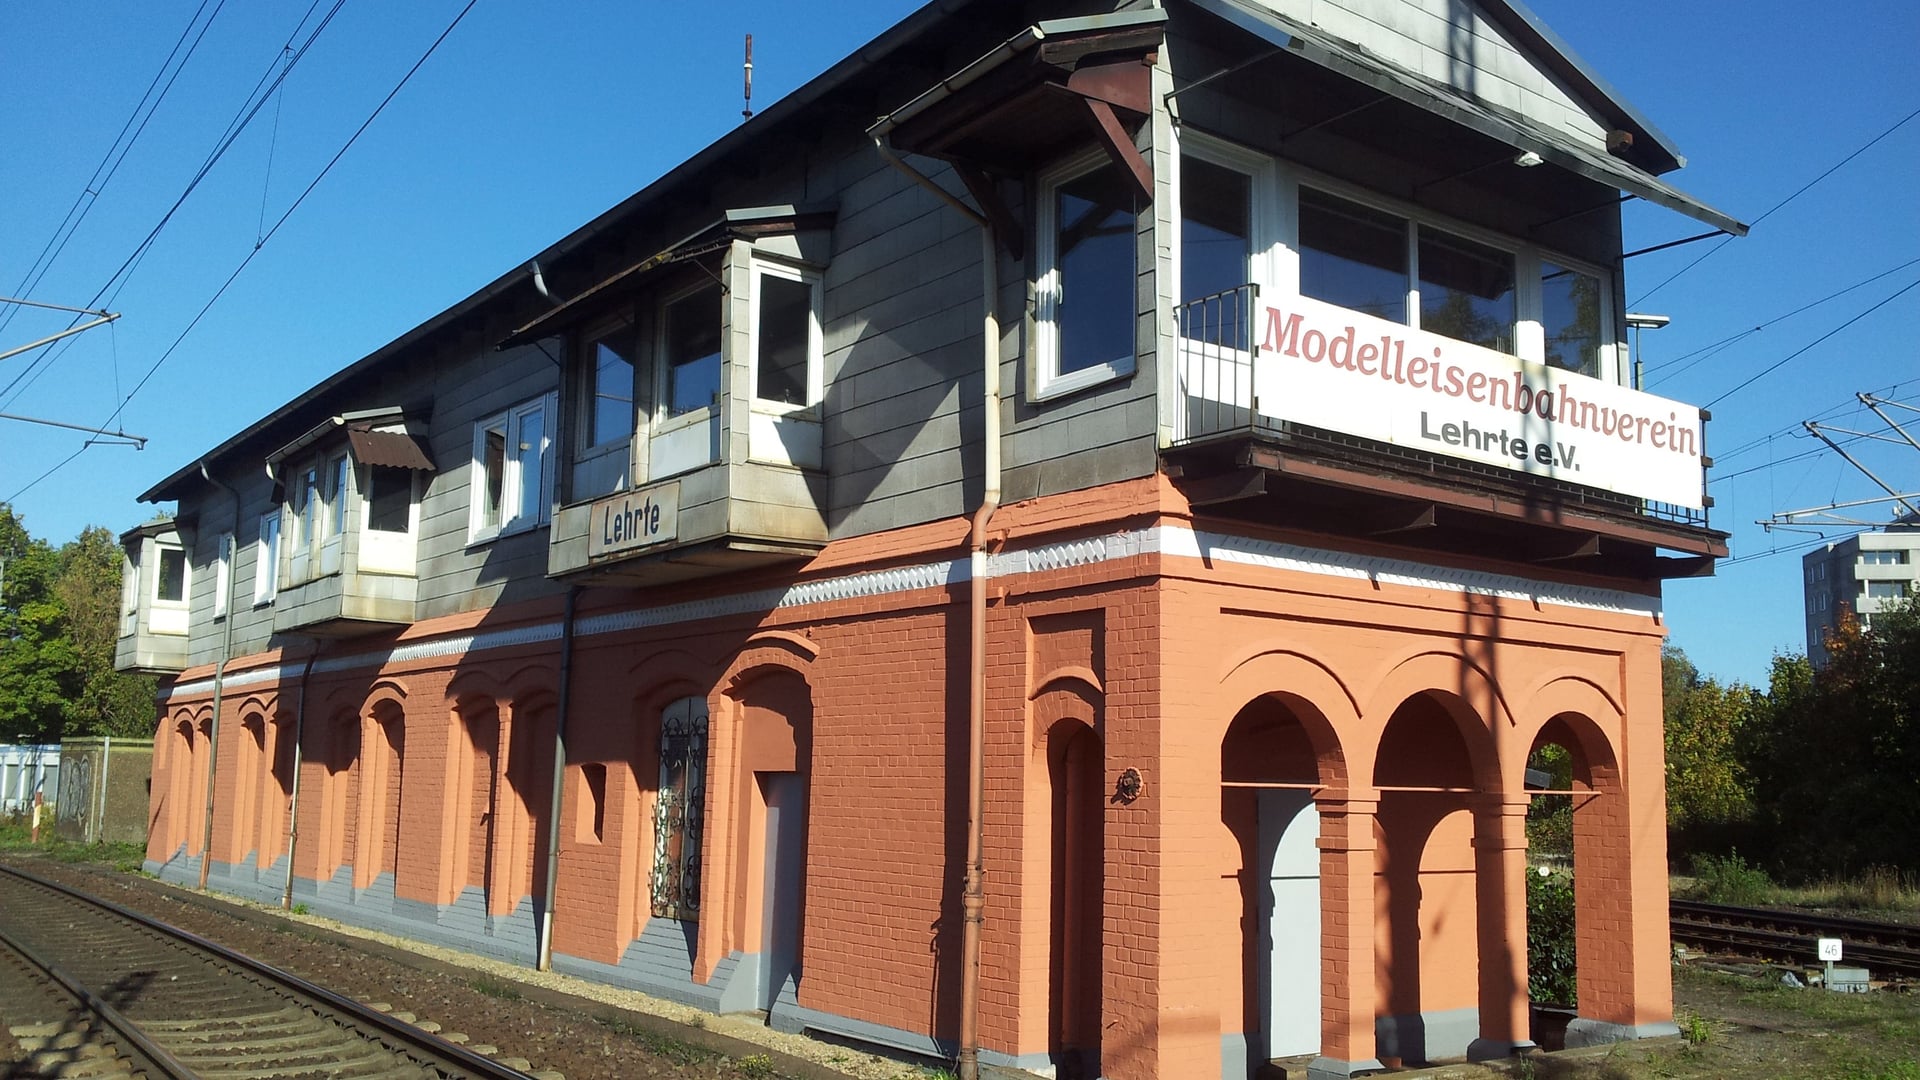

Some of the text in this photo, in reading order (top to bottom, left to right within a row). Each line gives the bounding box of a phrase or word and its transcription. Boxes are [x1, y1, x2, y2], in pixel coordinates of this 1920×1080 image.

[1261, 306, 1696, 456] Modelleisenbahnverein
[1421, 411, 1580, 471] Lehrte e.V.
[604, 496, 660, 546] Lehrte
[1825, 944, 1837, 956] 46
